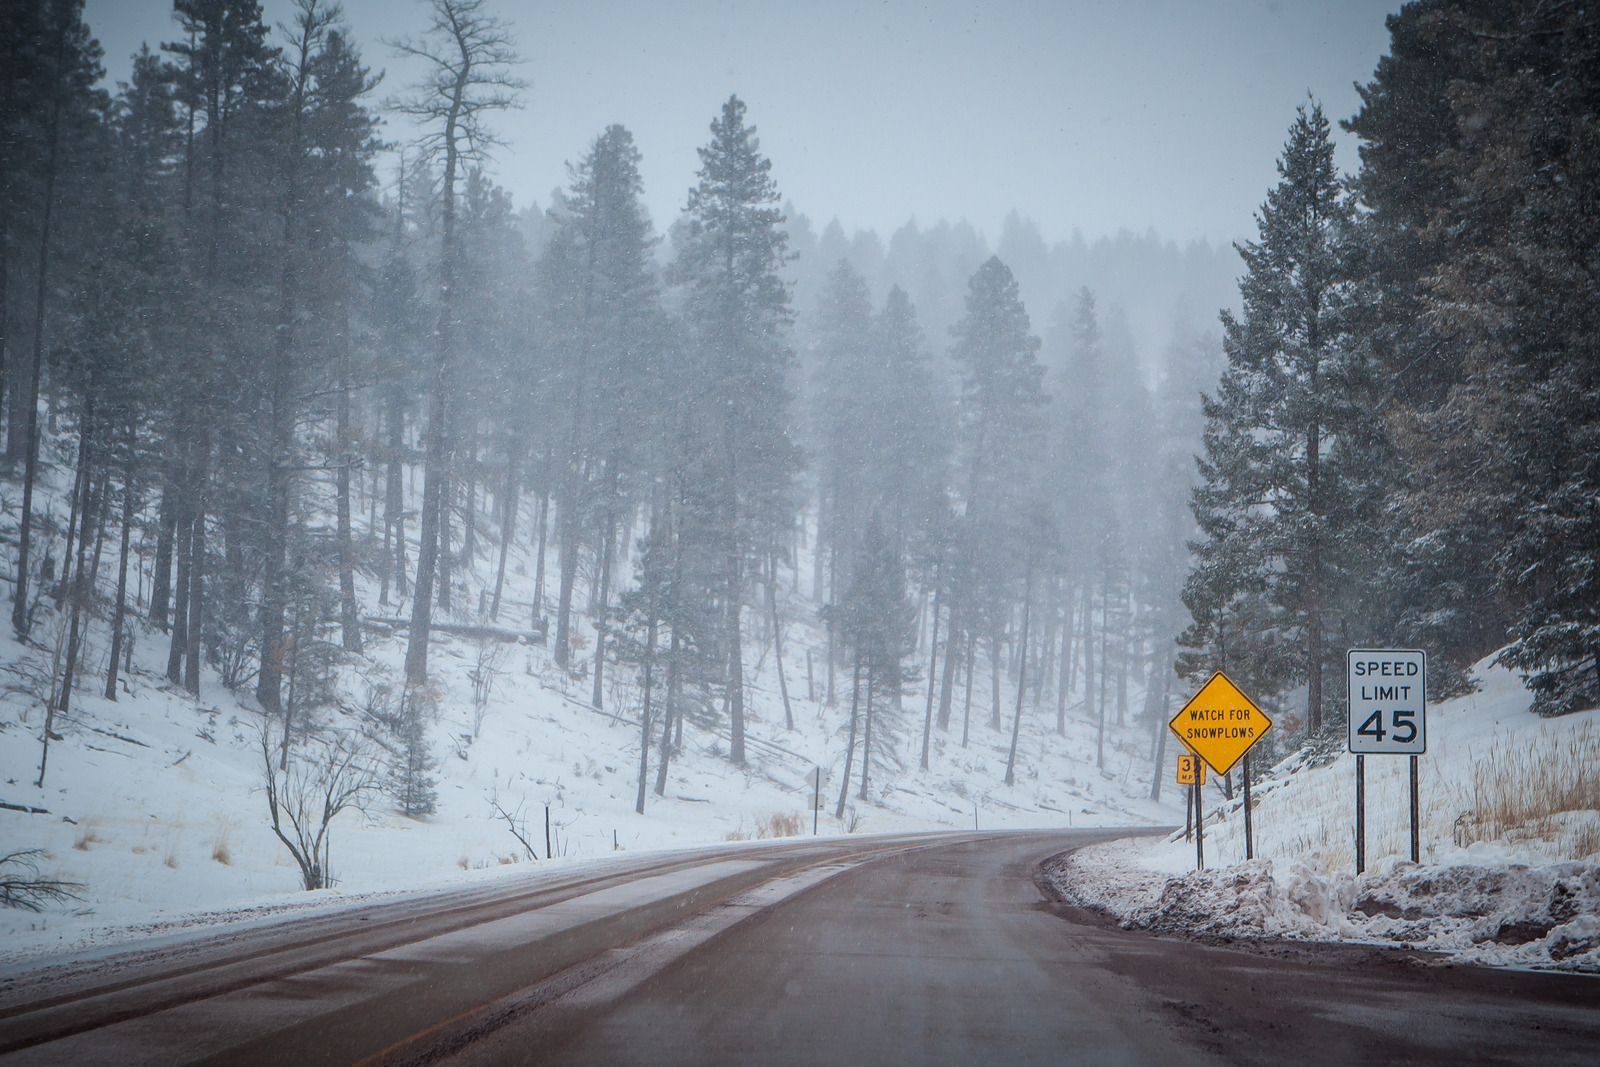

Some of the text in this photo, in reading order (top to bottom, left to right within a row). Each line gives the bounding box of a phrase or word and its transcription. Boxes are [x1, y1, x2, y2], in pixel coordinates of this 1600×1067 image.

[1355, 661, 1418, 676] SPEED
[1362, 686, 1411, 700] LIMIT
[1190, 709, 1250, 721] WATCH FOR
[1187, 727, 1254, 739] SNOWPLOWS
[1357, 710, 1417, 743] 45
